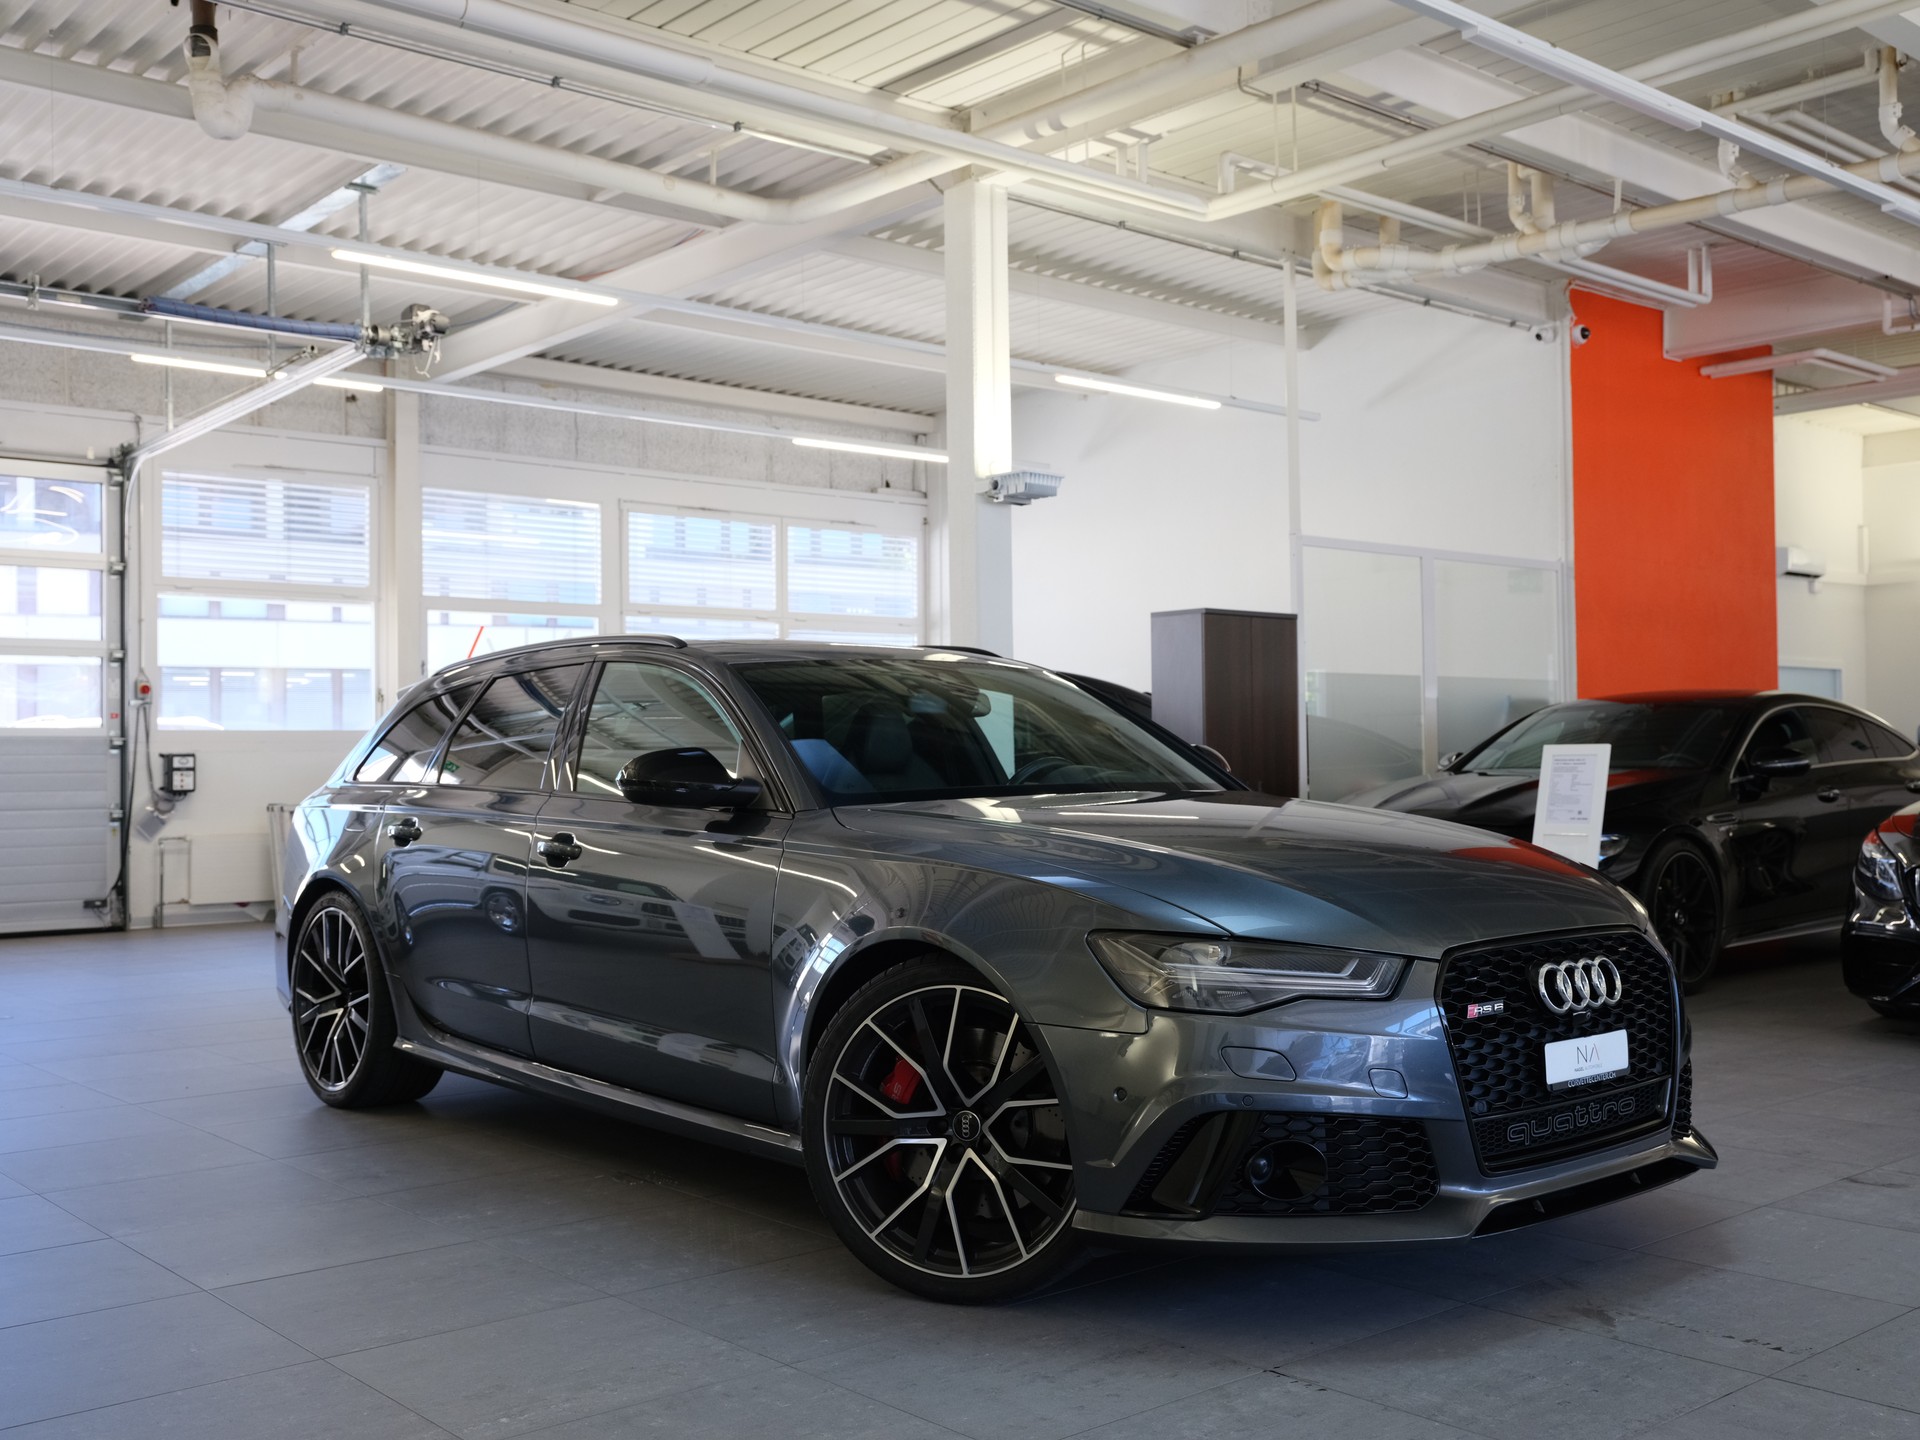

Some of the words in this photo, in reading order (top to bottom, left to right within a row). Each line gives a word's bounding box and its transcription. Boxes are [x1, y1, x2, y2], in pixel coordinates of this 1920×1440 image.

[1576, 1043, 1600, 1065] NA
[1567, 1071, 1617, 1088] CORVETTECENTER.CH
[1506, 1096, 1636, 1146] quattro
